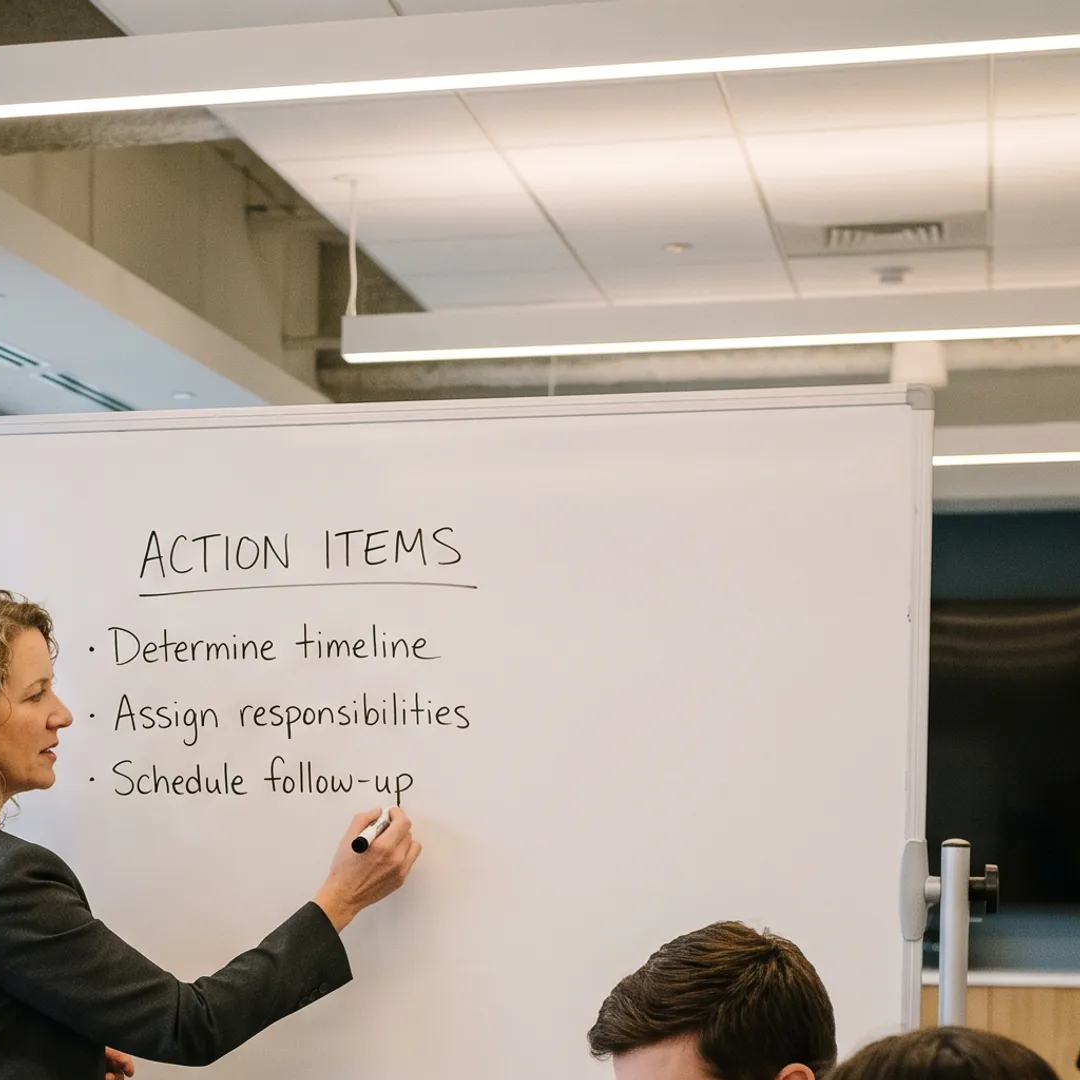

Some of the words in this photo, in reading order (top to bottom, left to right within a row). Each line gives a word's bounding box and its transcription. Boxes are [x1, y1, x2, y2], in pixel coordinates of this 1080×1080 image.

[140, 529, 290, 579] ACTION
[325, 526, 462, 570] ITEMS
[108, 626, 277, 666] Determine
[295, 623, 442, 661] timeline
[114, 693, 219, 747] Assign
[239, 692, 471, 740] responsibilities
[112, 759, 248, 797] Schedule
[263, 755, 414, 806] follow-up
